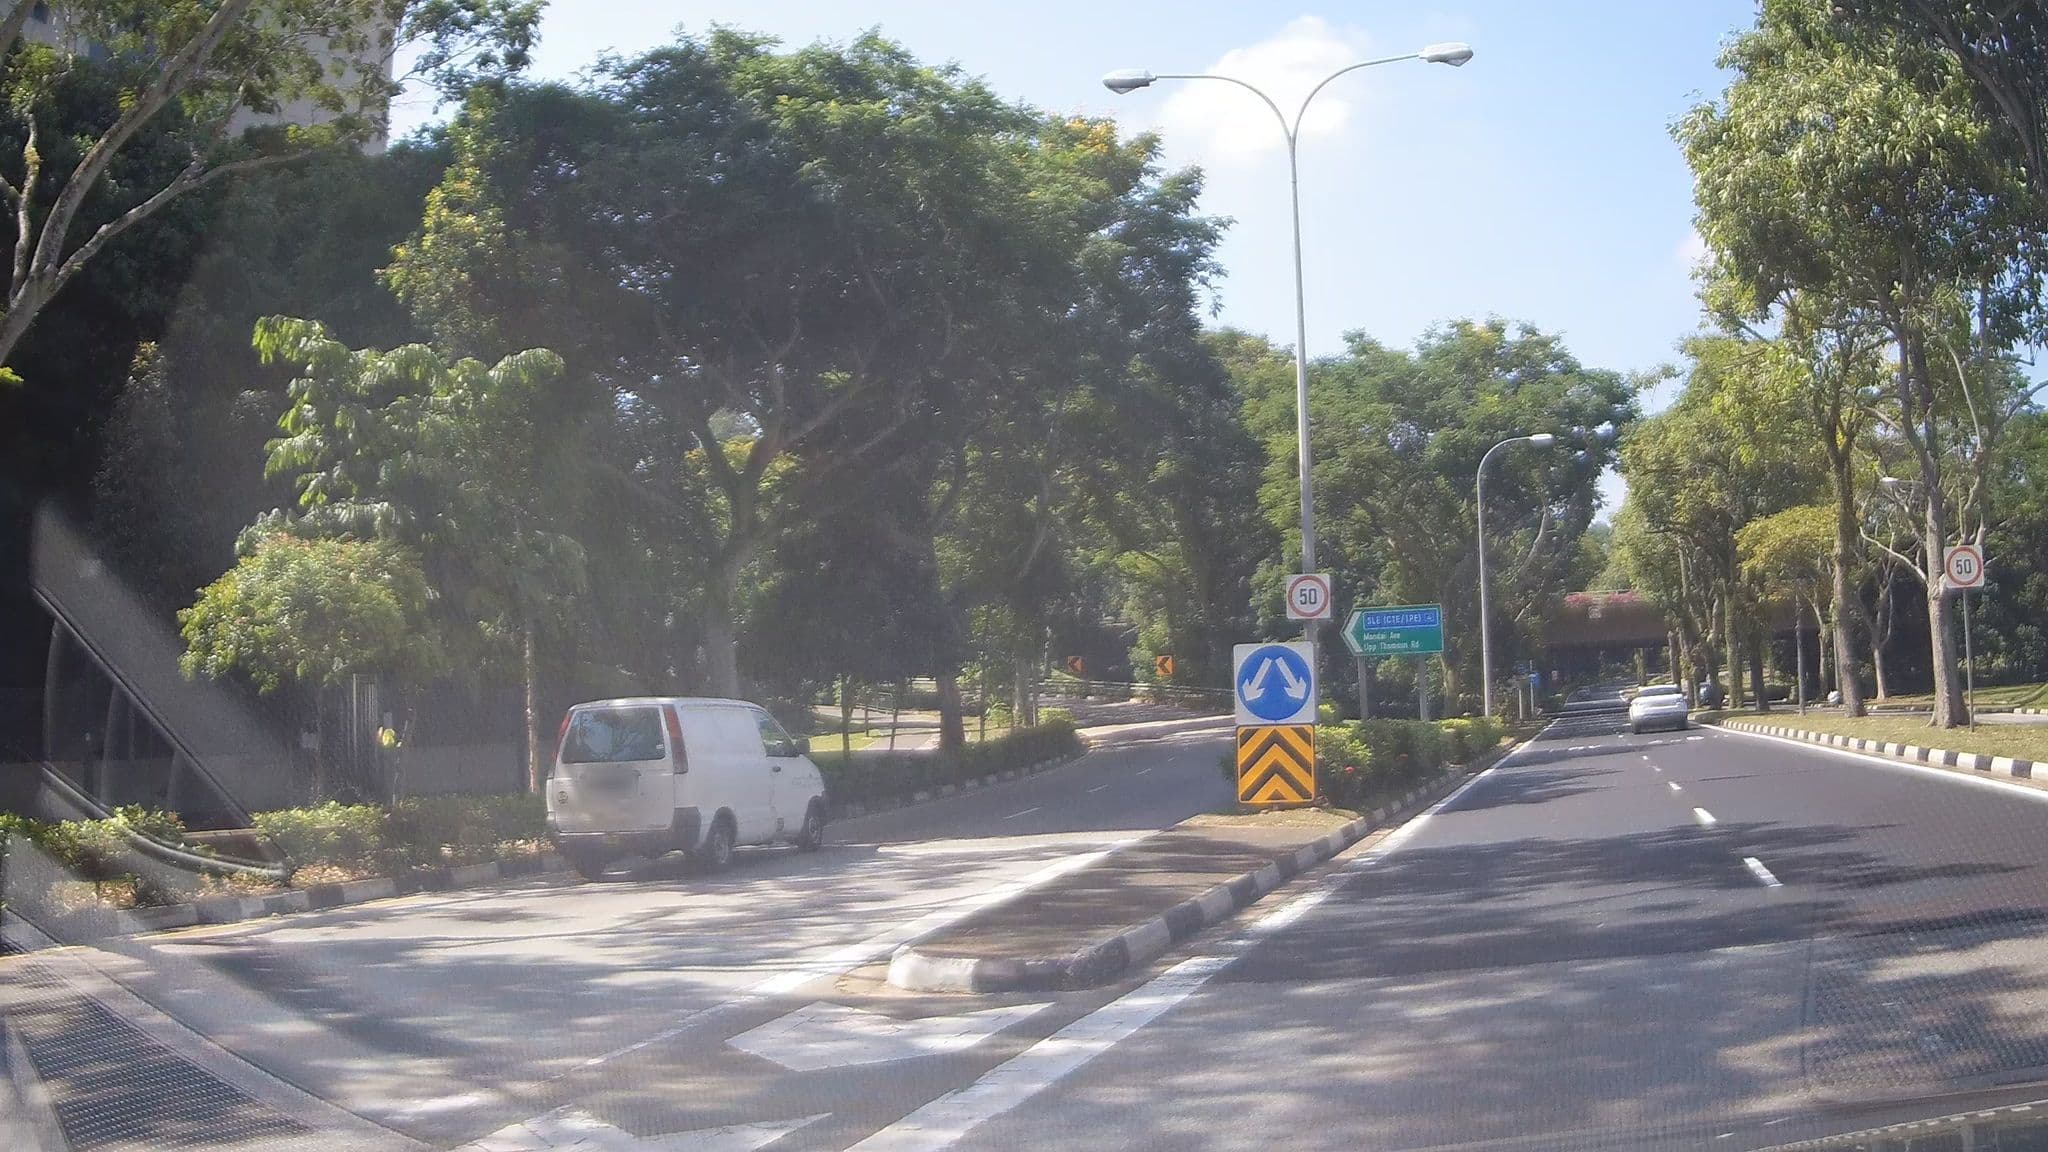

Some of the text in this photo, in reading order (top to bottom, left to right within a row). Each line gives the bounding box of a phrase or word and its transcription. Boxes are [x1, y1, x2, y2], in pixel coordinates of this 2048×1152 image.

[1956, 558, 1972, 574] 50
[1299, 588, 1317, 605] 50
[1367, 616, 1381, 625] SLE
